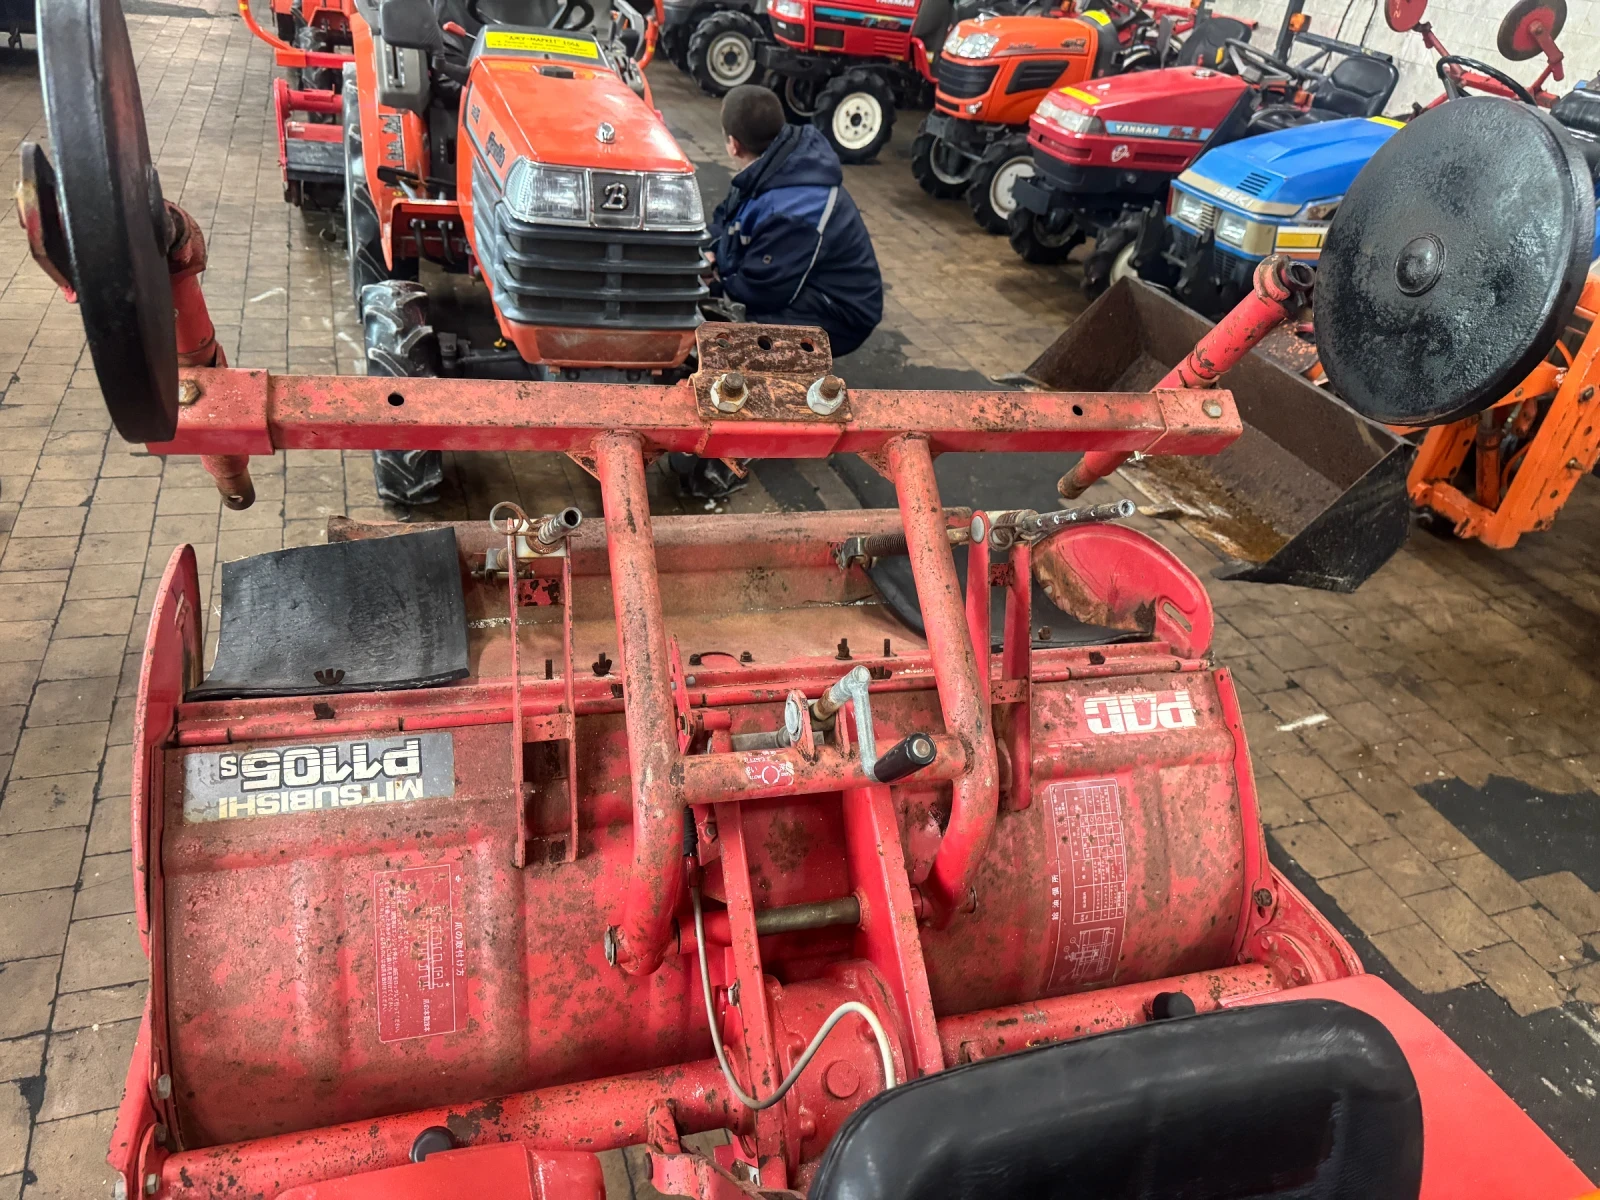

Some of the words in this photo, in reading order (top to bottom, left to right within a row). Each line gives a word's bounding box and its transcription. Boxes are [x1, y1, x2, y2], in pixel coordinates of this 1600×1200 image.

[1114, 124, 1160, 136] YANMAR
[218, 779, 424, 819] MITSUBISHI
[454, 921, 465, 977] 爪の取付け方
